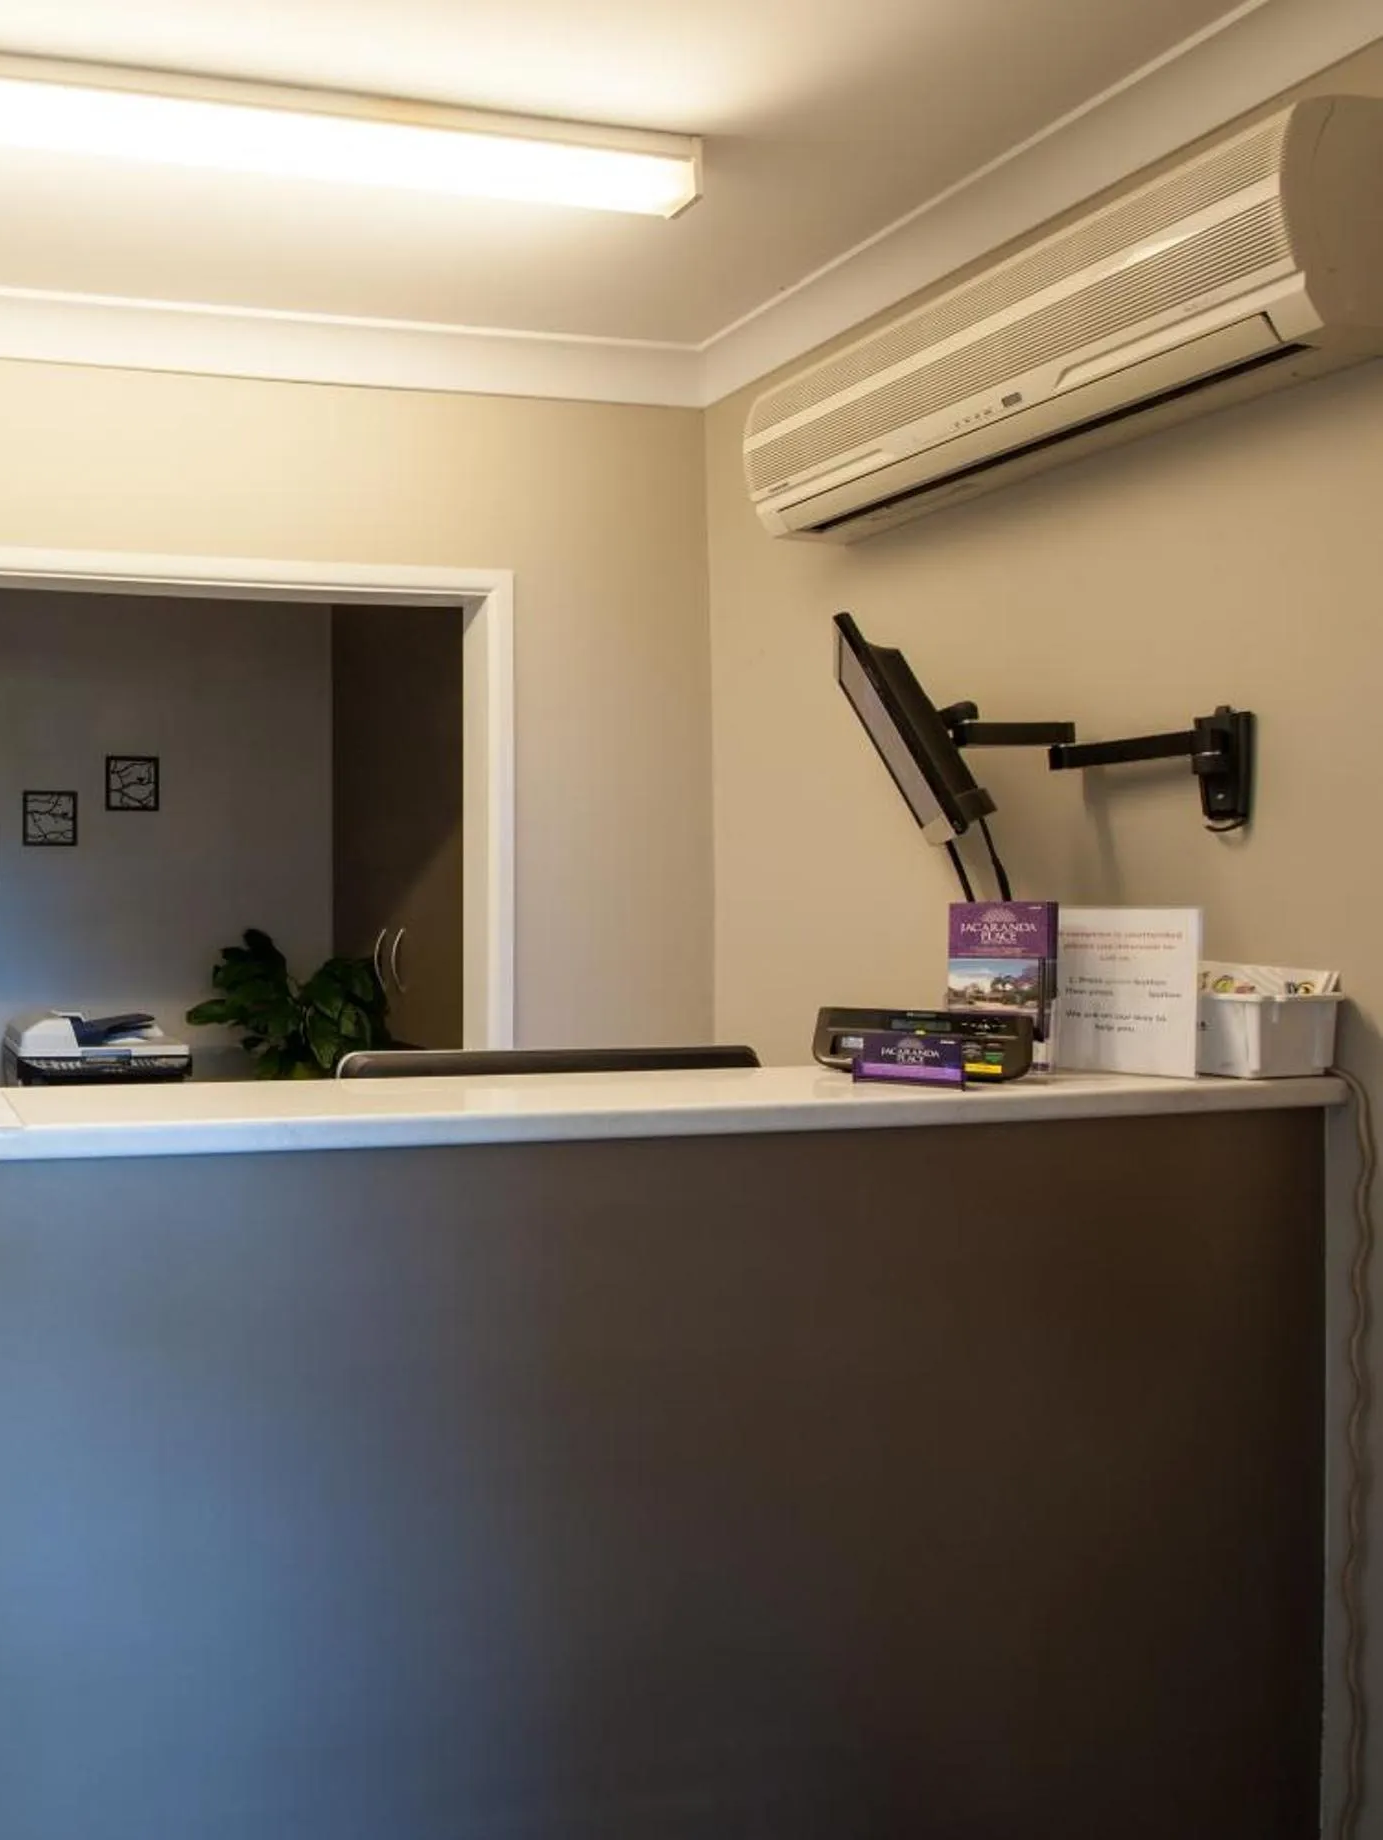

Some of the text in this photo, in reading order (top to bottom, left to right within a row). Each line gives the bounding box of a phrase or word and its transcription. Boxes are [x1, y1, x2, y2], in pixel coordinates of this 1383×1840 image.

[960, 922, 1038, 934] JACARANDA
[980, 931, 1018, 942] PLACE
[880, 1046, 940, 1059] JACARANDA
